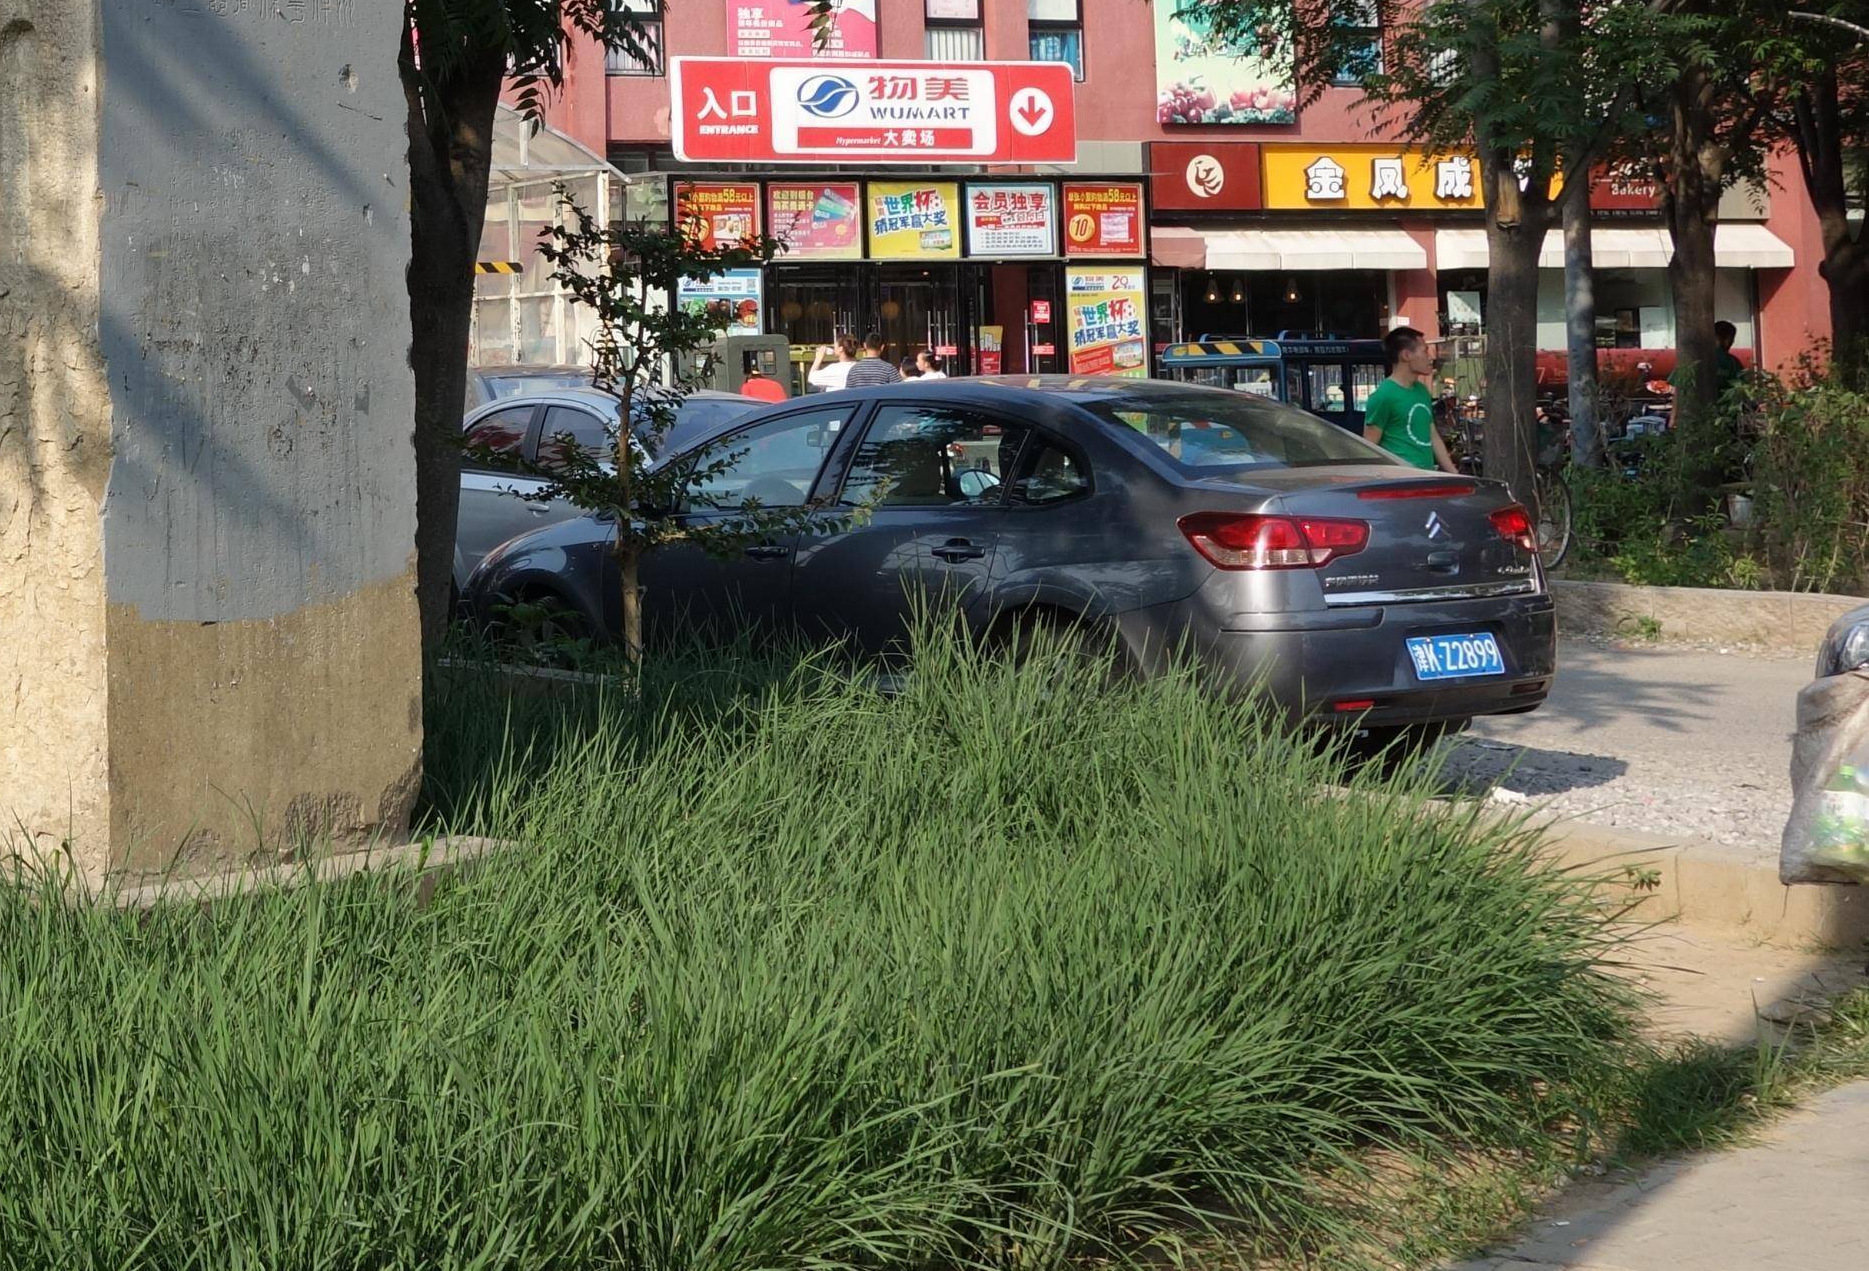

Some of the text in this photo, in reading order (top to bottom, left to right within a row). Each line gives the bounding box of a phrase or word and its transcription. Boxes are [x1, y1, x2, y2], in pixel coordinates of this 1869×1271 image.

[868, 75, 970, 102] 物美
[697, 86, 758, 121] 入口
[870, 105, 971, 122] WUMART
[699, 124, 759, 135] ENTRANCE
[835, 130, 935, 147] Hypermarket 大卖场
[1611, 182, 1656, 198] Bakery
[884, 190, 937, 215] 世界杯
[974, 191, 1046, 211] 会员独享
[874, 209, 948, 235] 猜冠军赢大奖
[1072, 218, 1089, 237] 10
[1081, 297, 1129, 326] 世界杯
